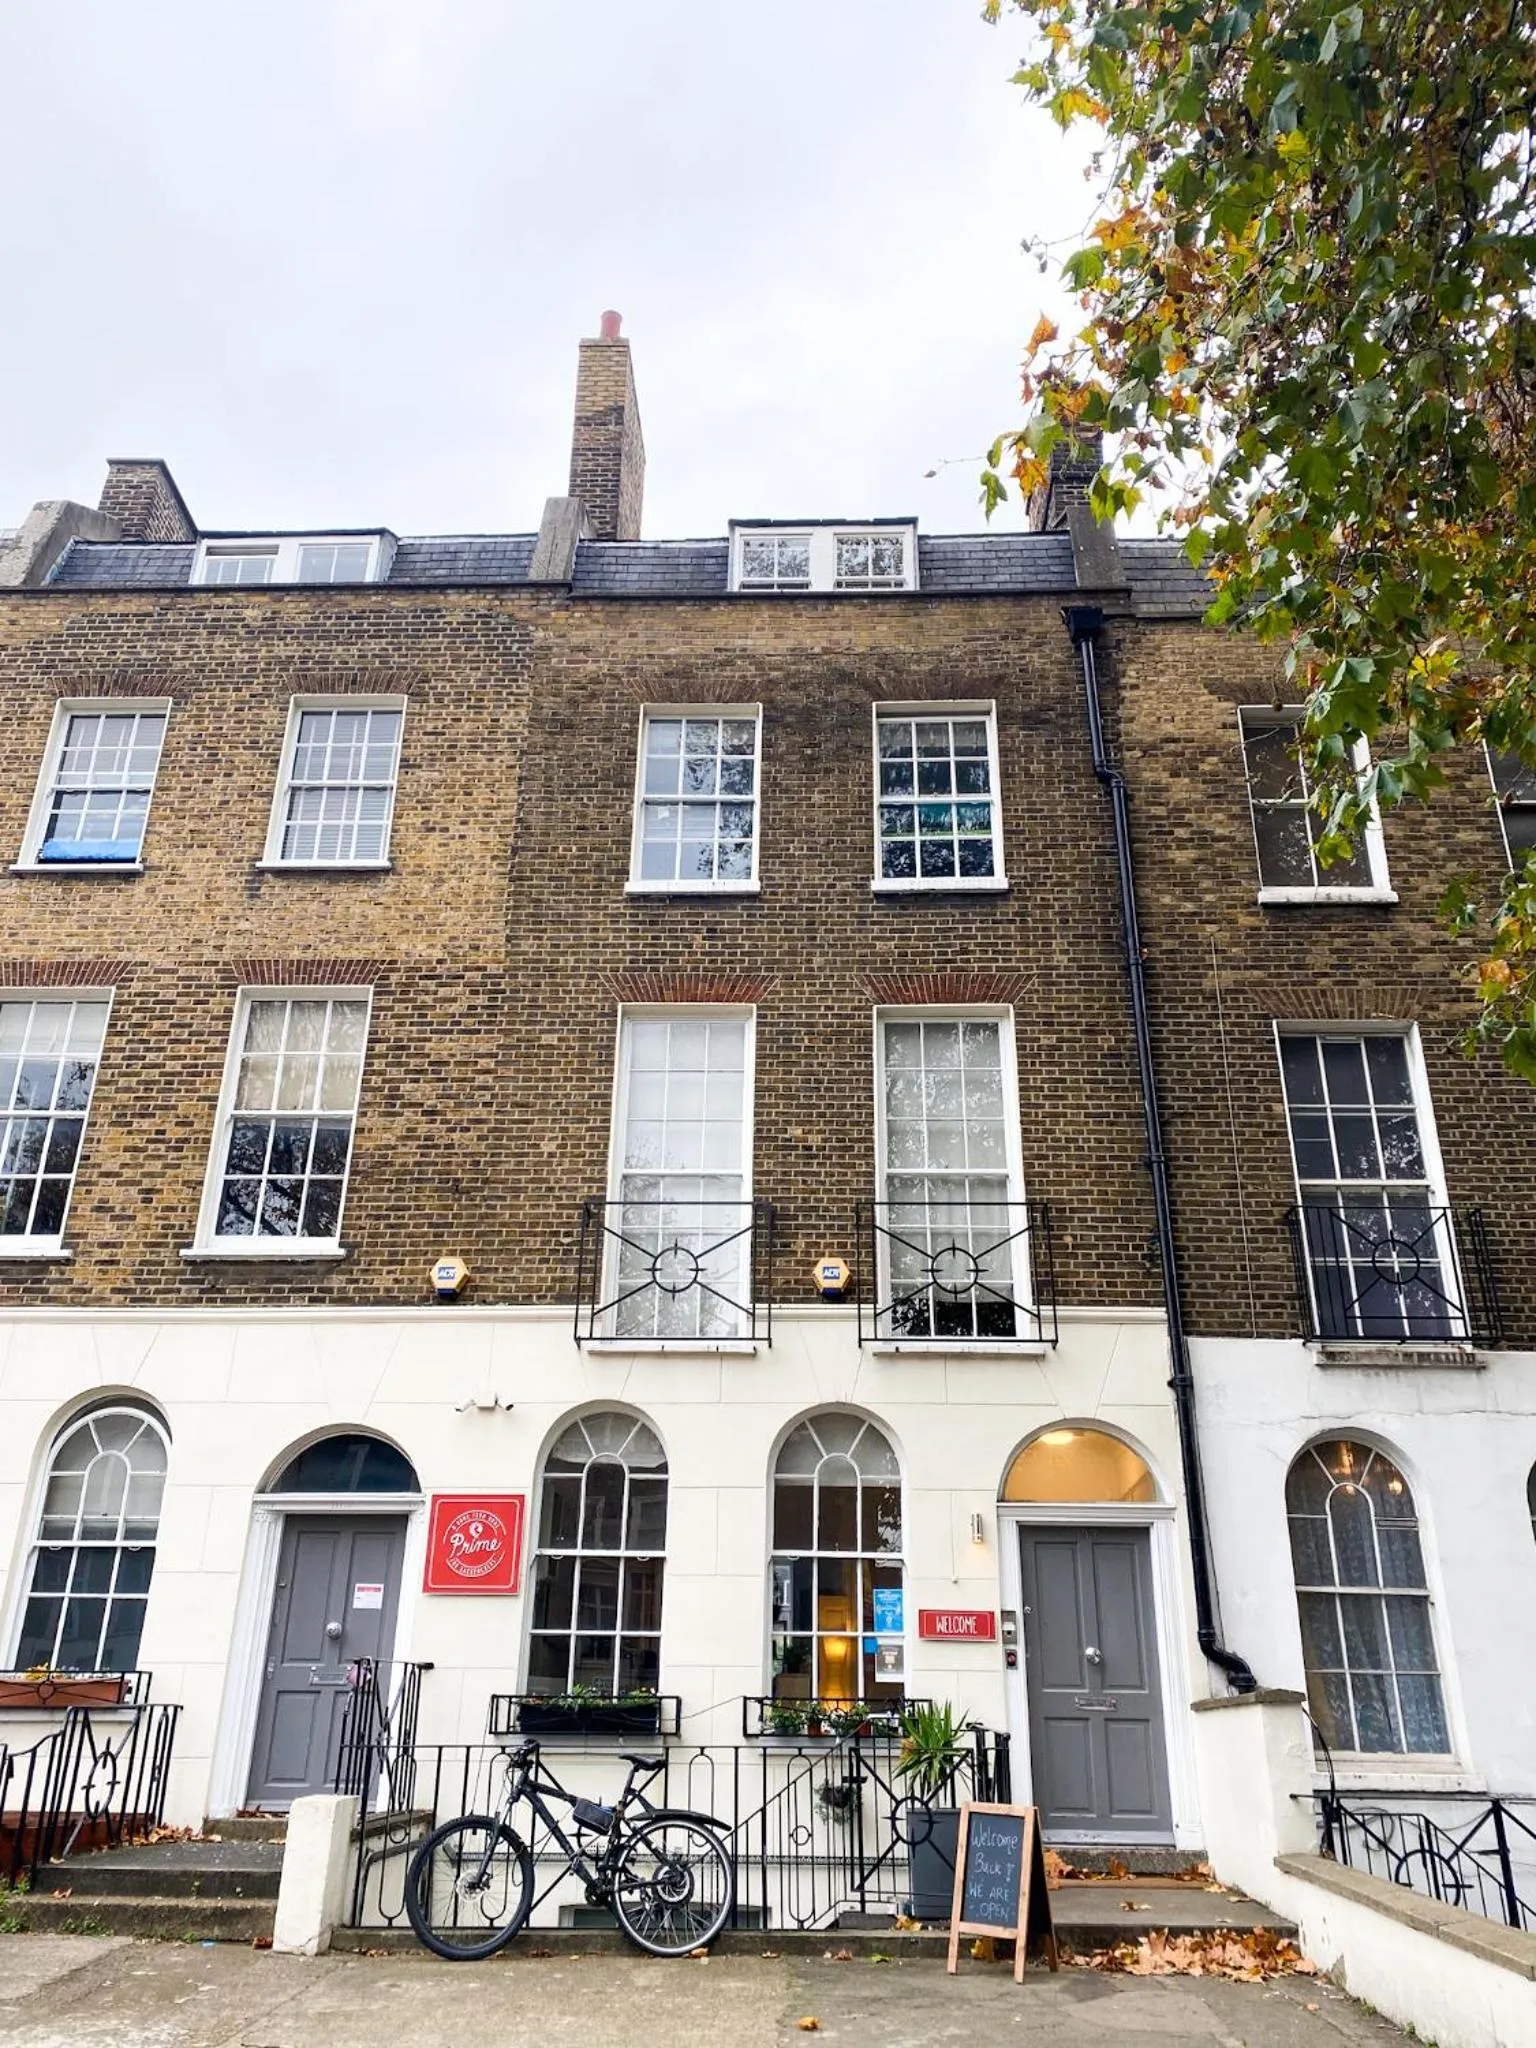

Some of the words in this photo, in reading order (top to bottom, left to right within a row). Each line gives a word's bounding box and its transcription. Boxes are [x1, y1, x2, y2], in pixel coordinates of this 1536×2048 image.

[449, 1533, 502, 1559] Prime
[936, 1616, 978, 1634] WELCOME
[971, 1820, 1019, 1851] Welcome
[968, 1881, 984, 1898] WE
[989, 1886, 1010, 1901] ARE
[980, 1902, 1009, 1922] OPEN
